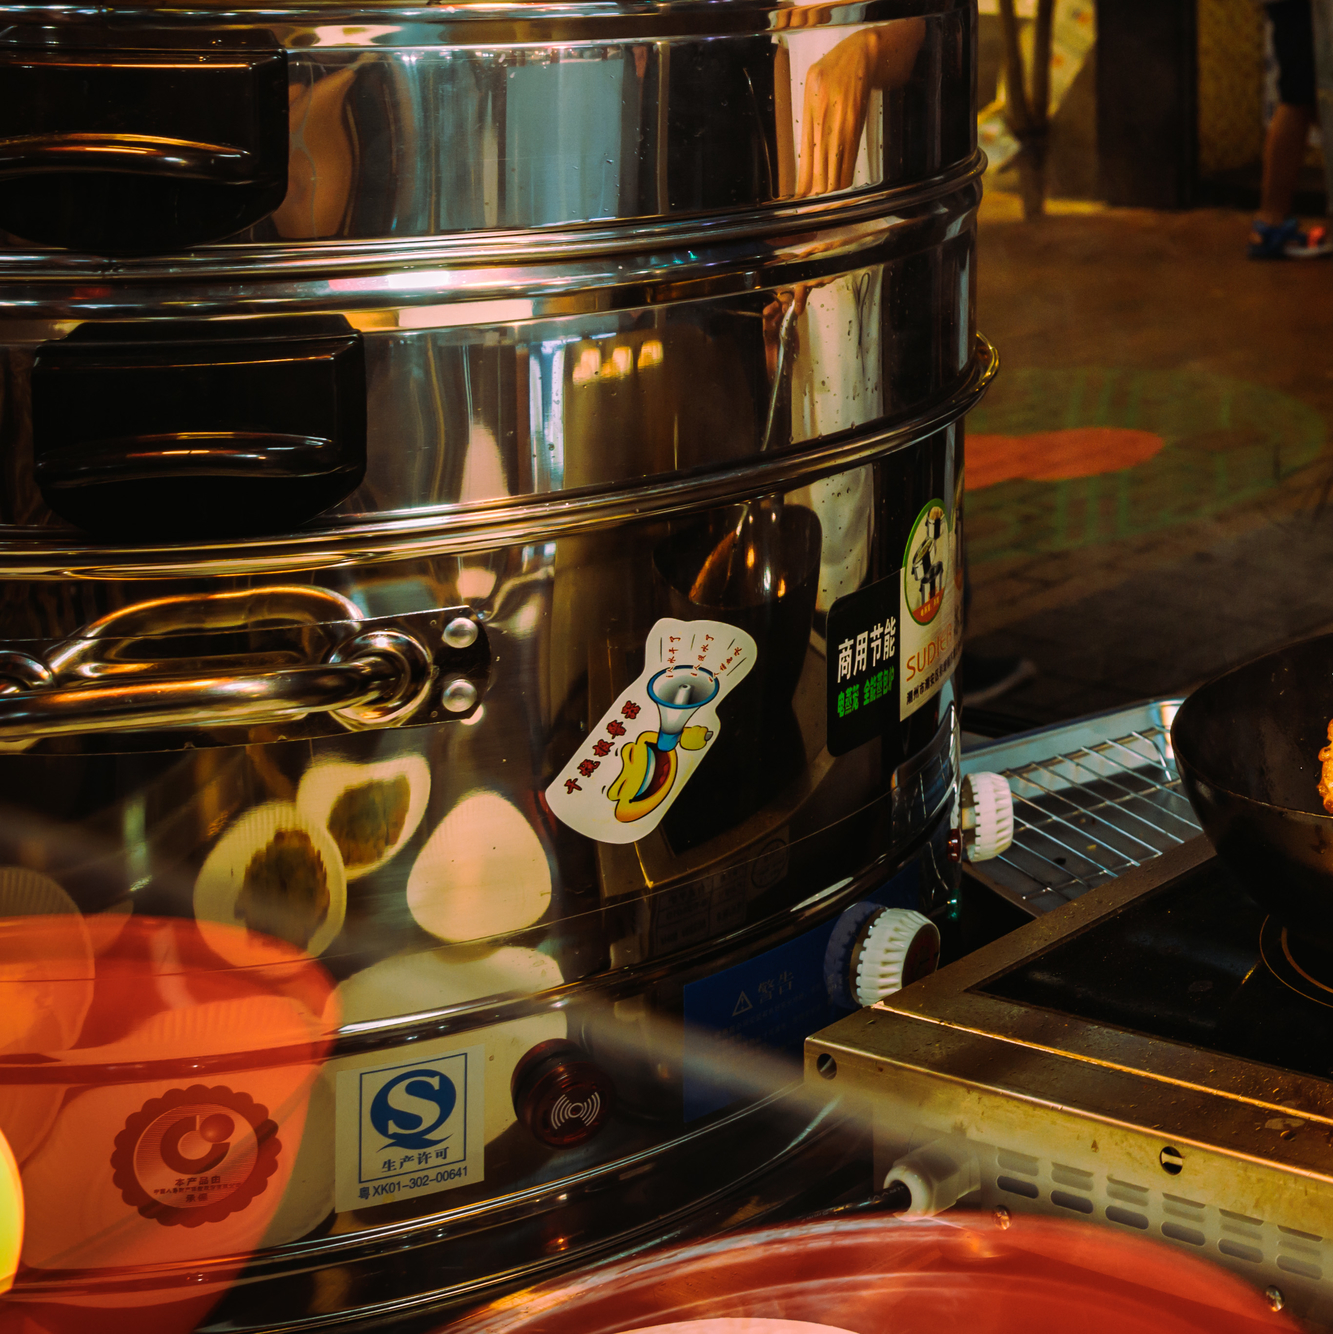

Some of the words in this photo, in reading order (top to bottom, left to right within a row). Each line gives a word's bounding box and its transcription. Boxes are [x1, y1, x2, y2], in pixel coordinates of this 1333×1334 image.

[666, 635, 681, 678] 人水干了
[837, 616, 896, 684] 商用节能
[906, 623, 952, 682] SUDIER
[381, 1146, 450, 1173] 生产许可
[174, 1175, 221, 1187] 本产品由
[185, 1193, 208, 1203] 承保
